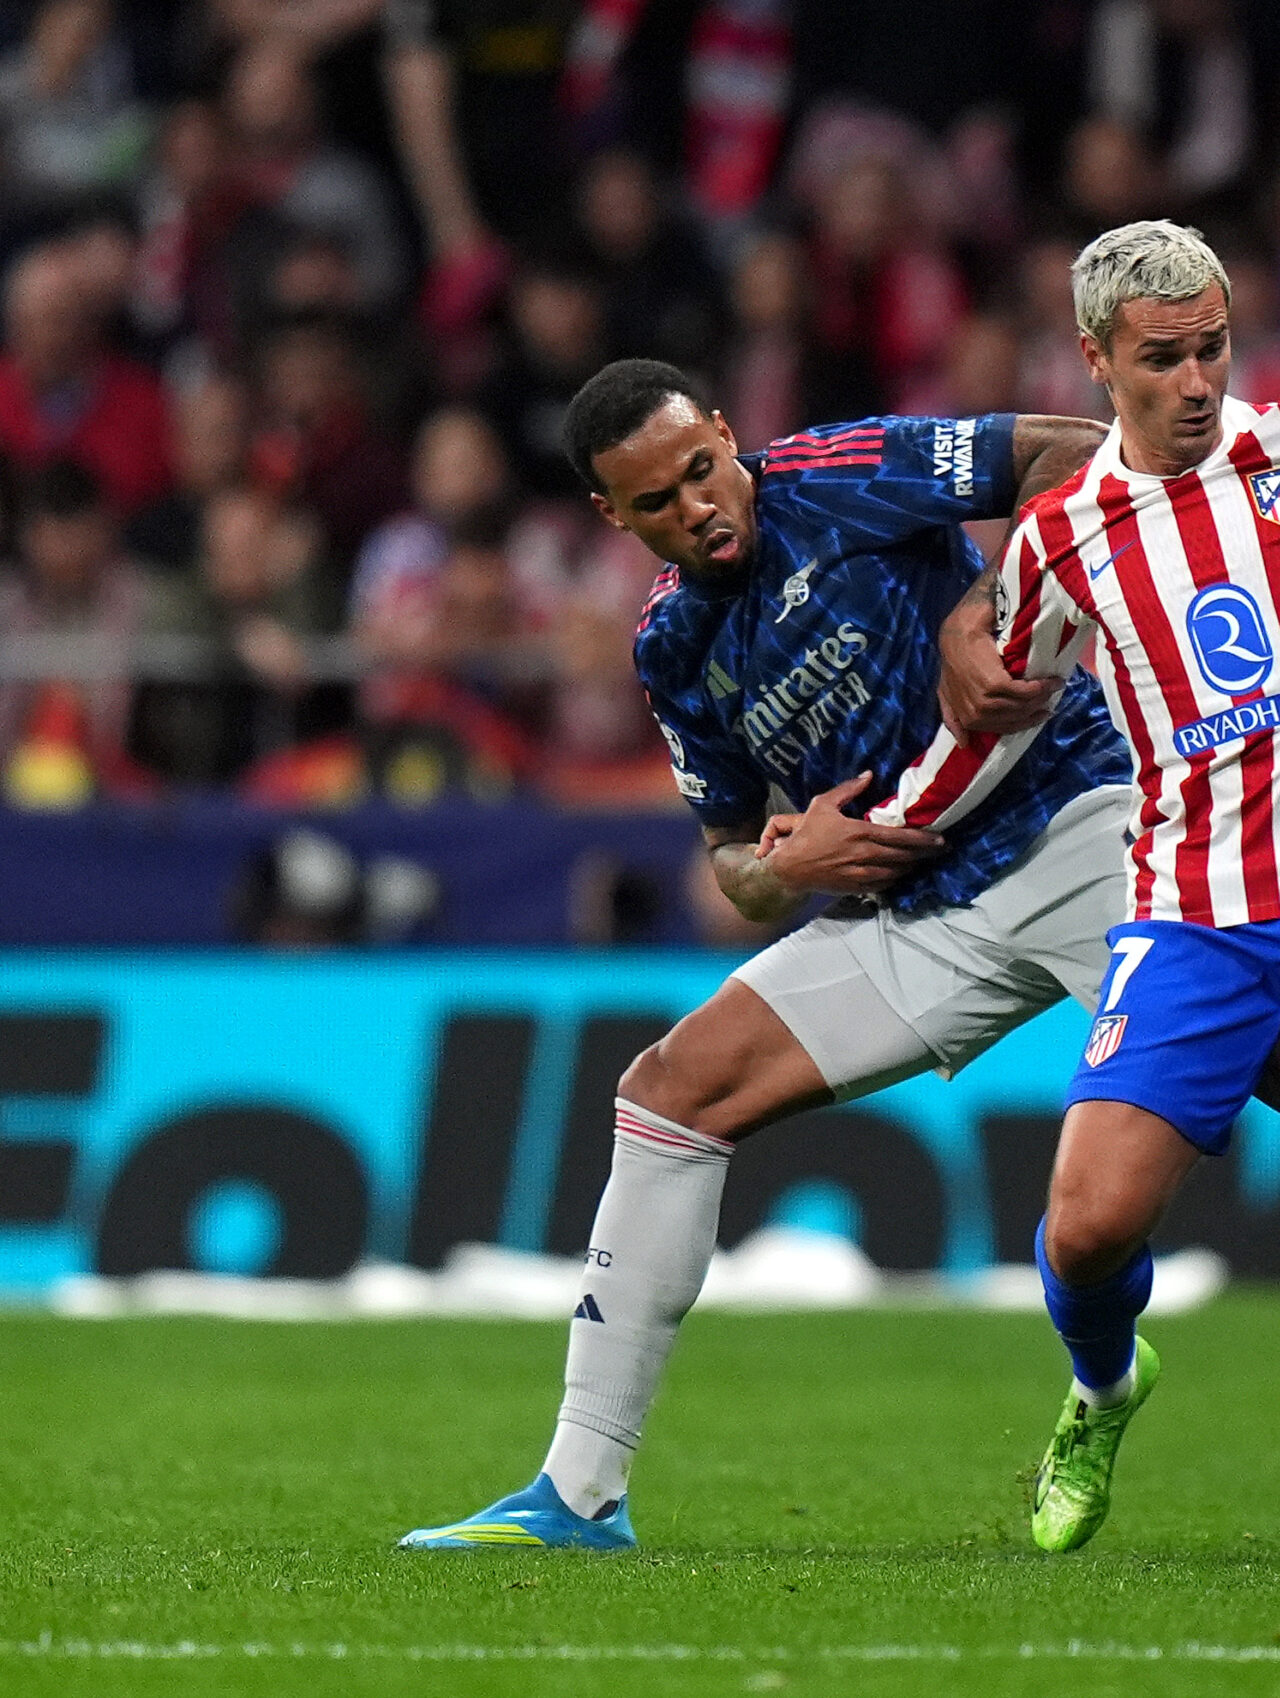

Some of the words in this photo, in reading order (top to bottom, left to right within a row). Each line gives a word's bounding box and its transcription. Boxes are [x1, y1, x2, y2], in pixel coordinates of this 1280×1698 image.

[933, 426, 954, 476] VISIT
[796, 671, 872, 748] BETTER
[1179, 699, 1280, 753] RIYADH
[1103, 936, 1155, 1012] 7
